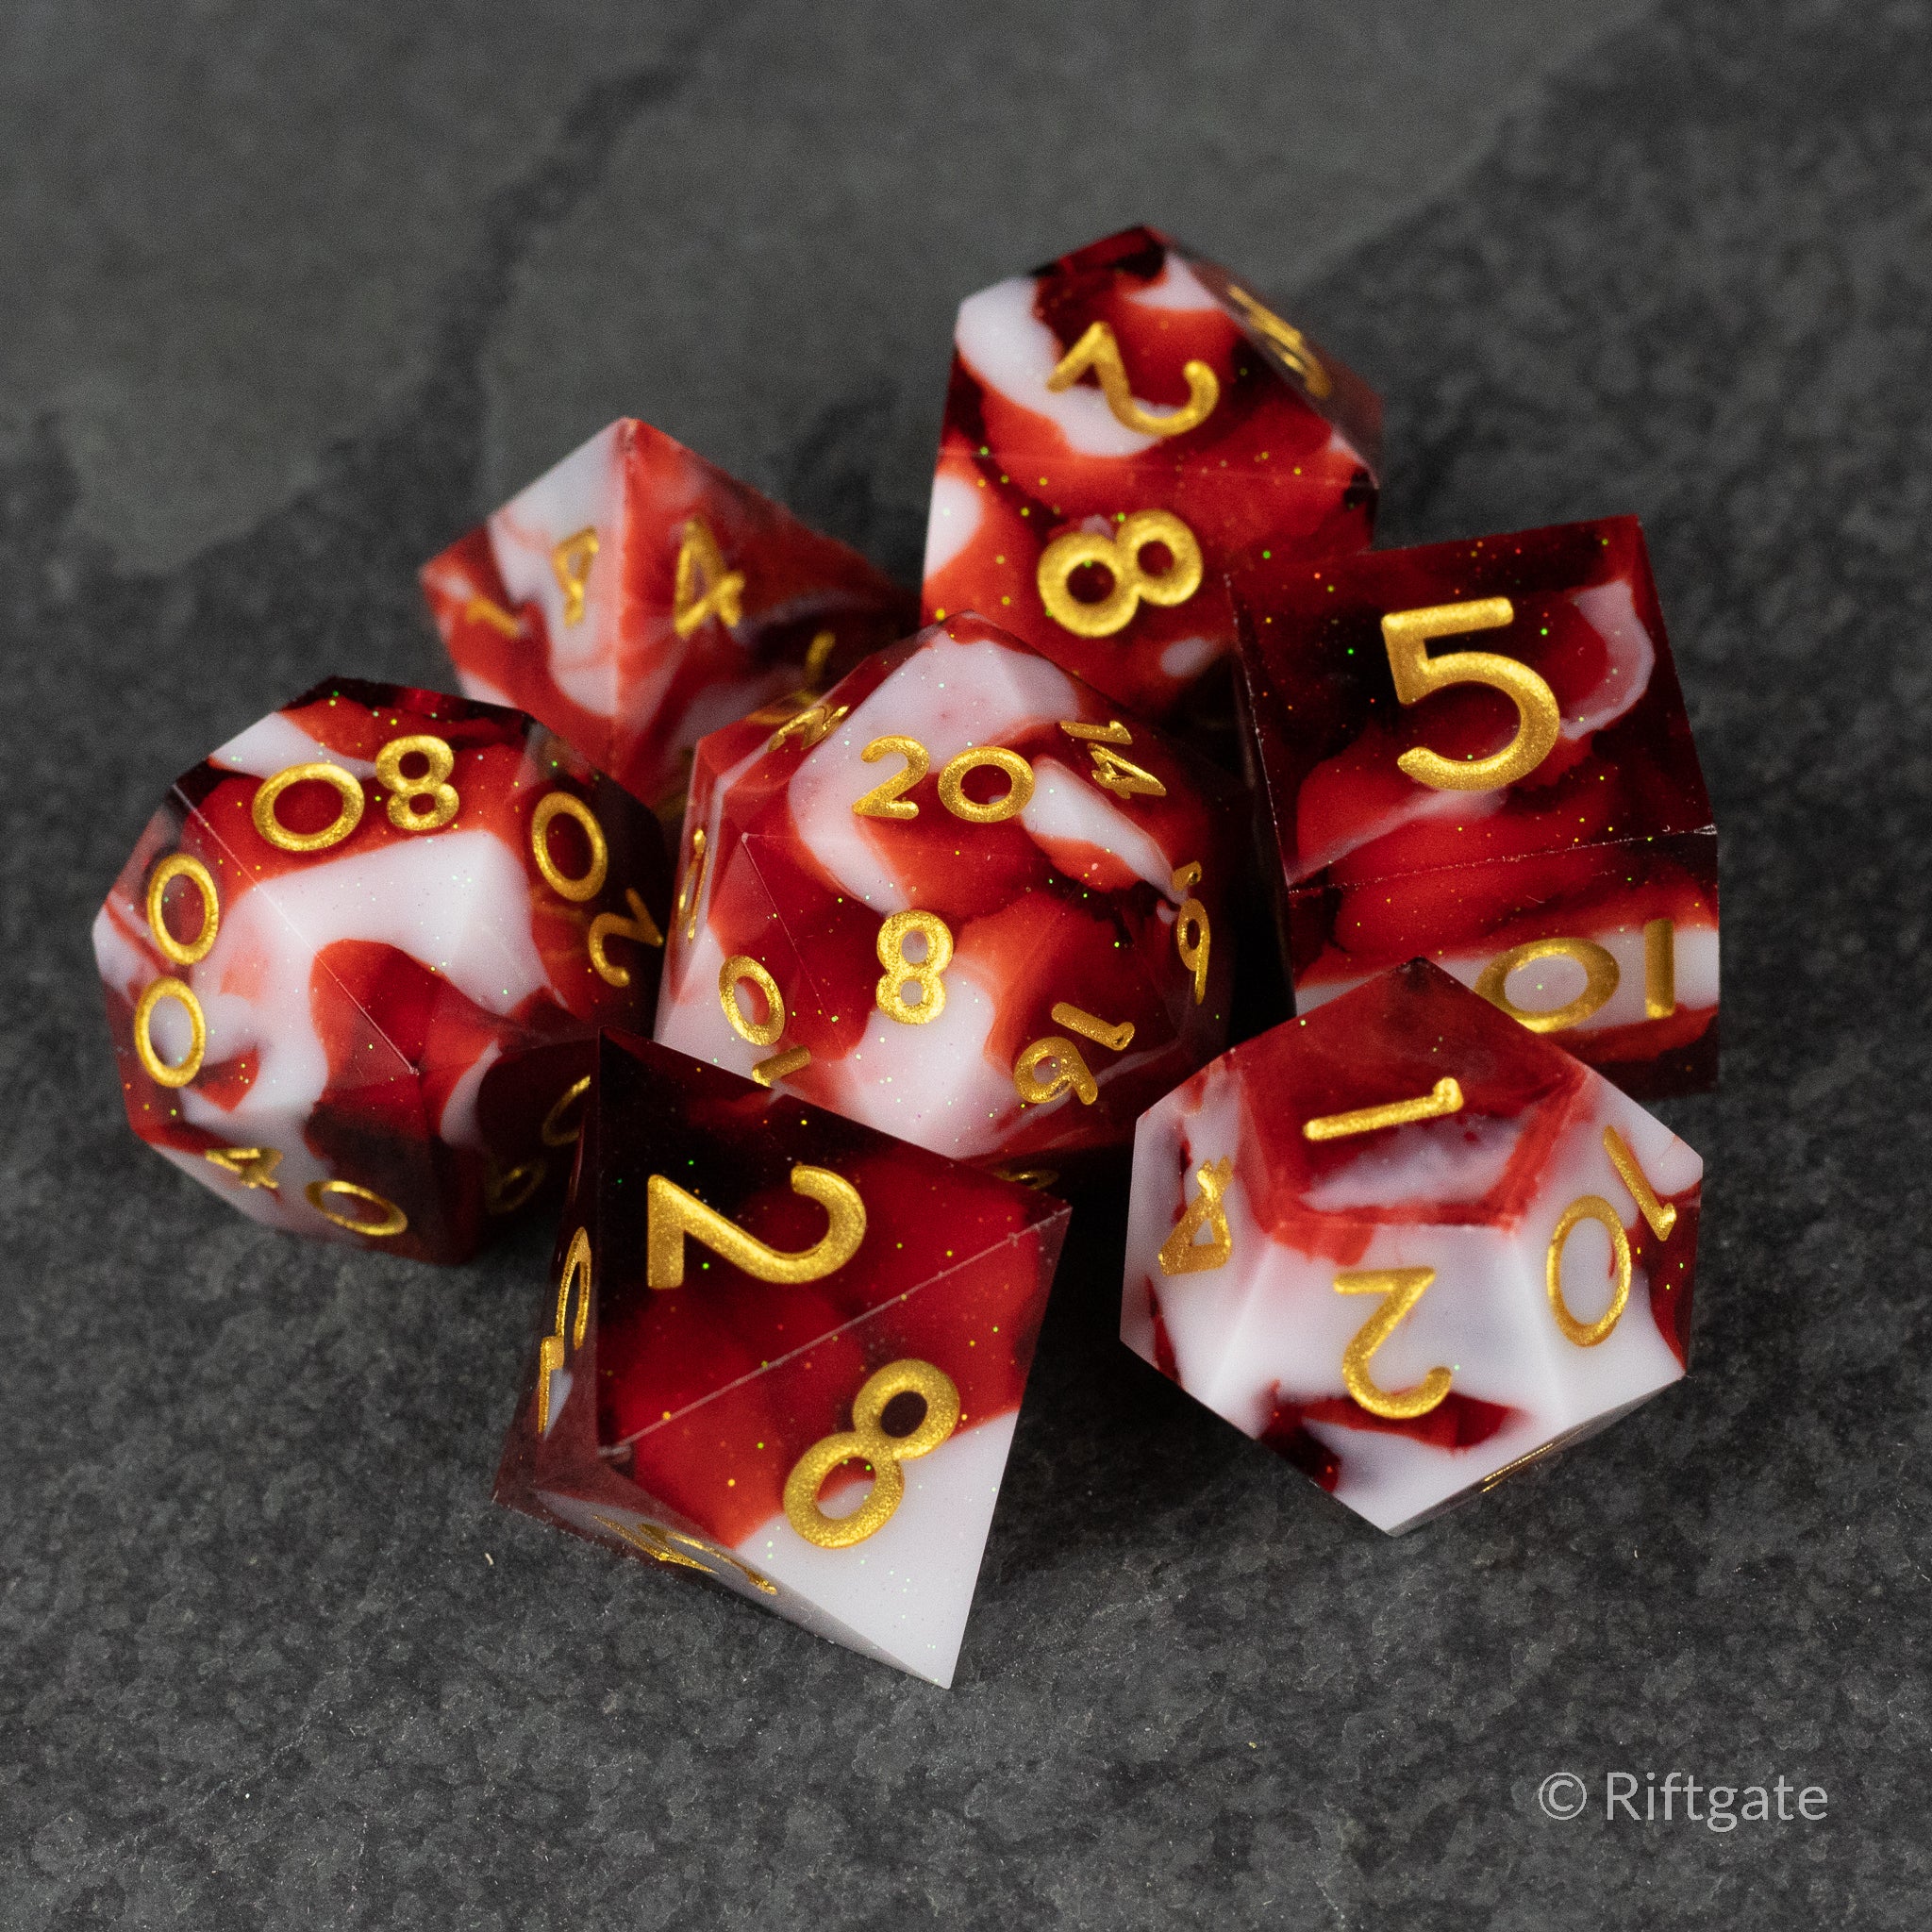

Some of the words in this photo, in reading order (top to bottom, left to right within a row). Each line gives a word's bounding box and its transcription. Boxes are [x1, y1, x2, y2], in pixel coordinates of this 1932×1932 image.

[1045, 321, 1221, 438] 2
[674, 519, 746, 638] 4
[1037, 508, 1205, 639] 8
[1380, 595, 1561, 791] 5
[852, 734, 1036, 824] 20
[875, 909, 954, 1025] 8
[646, 1163, 868, 1291] 2
[1331, 1265, 1454, 1420] 2
[782, 1358, 960, 1550] 8
